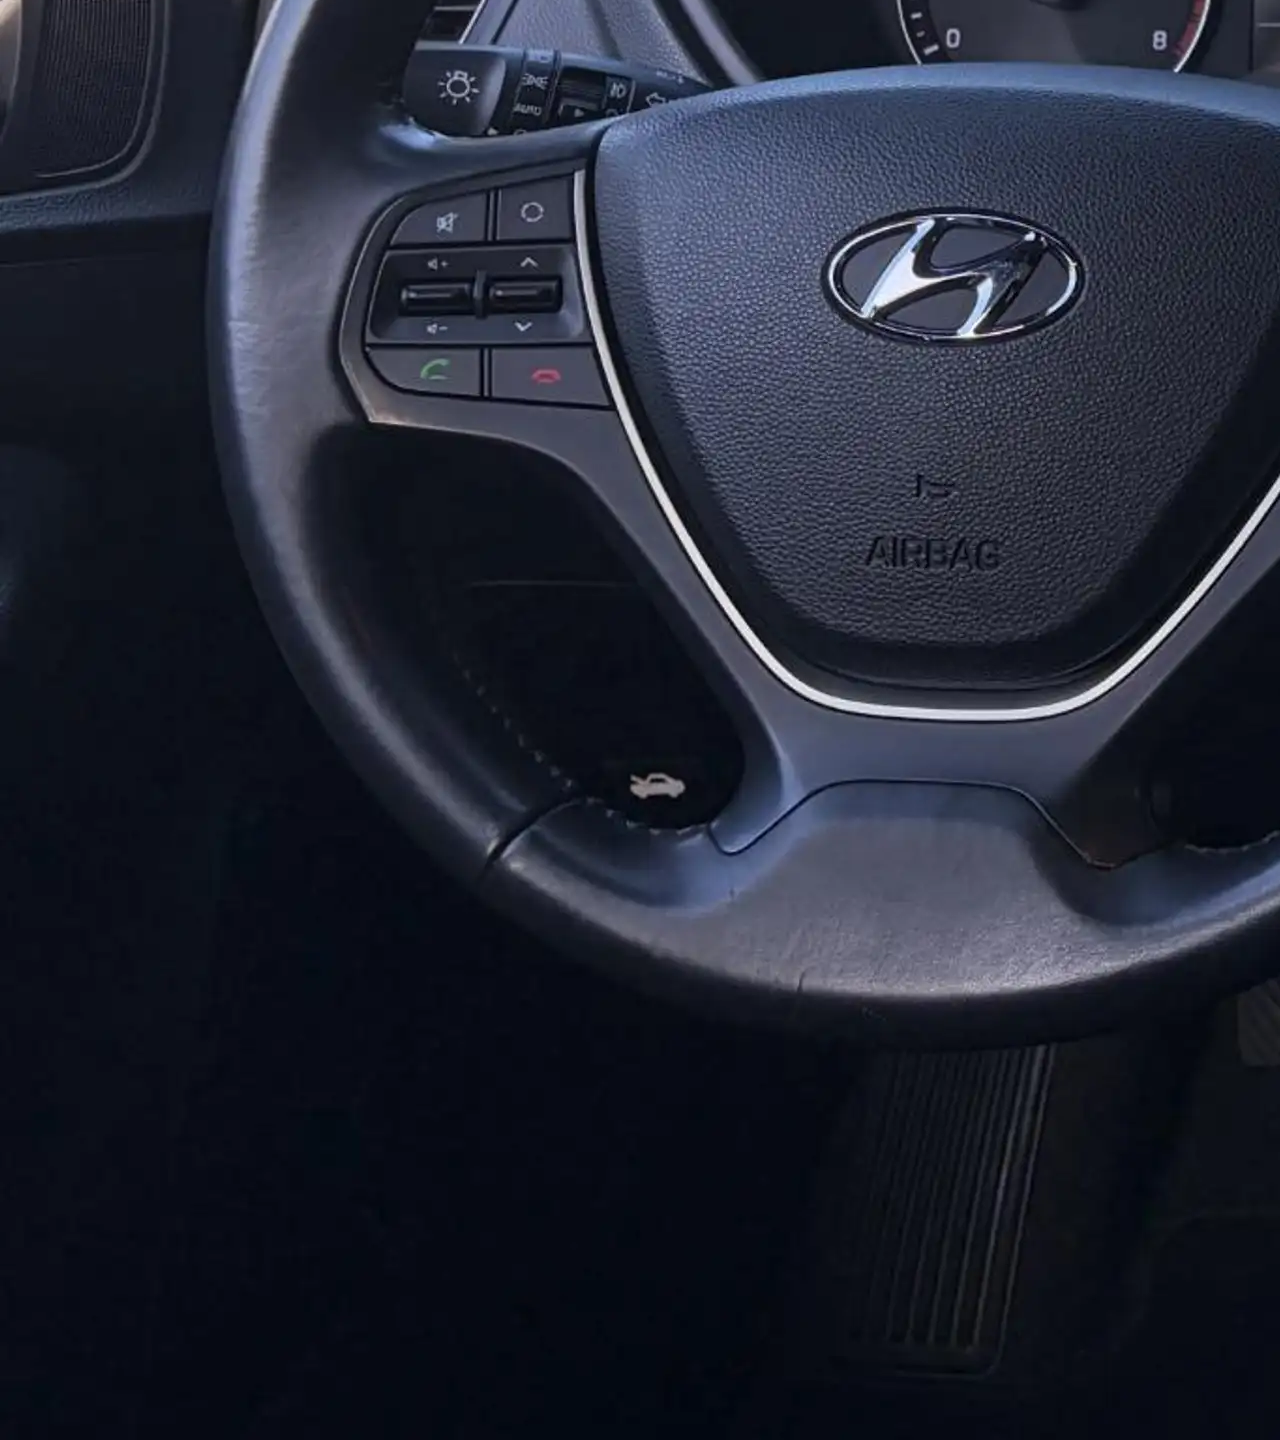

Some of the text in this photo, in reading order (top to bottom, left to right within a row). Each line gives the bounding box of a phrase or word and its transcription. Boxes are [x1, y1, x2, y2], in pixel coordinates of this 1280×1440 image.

[946, 28, 960, 48] 0
[1152, 30, 1167, 50] 8
[866, 536, 1001, 571] AIRBAG
